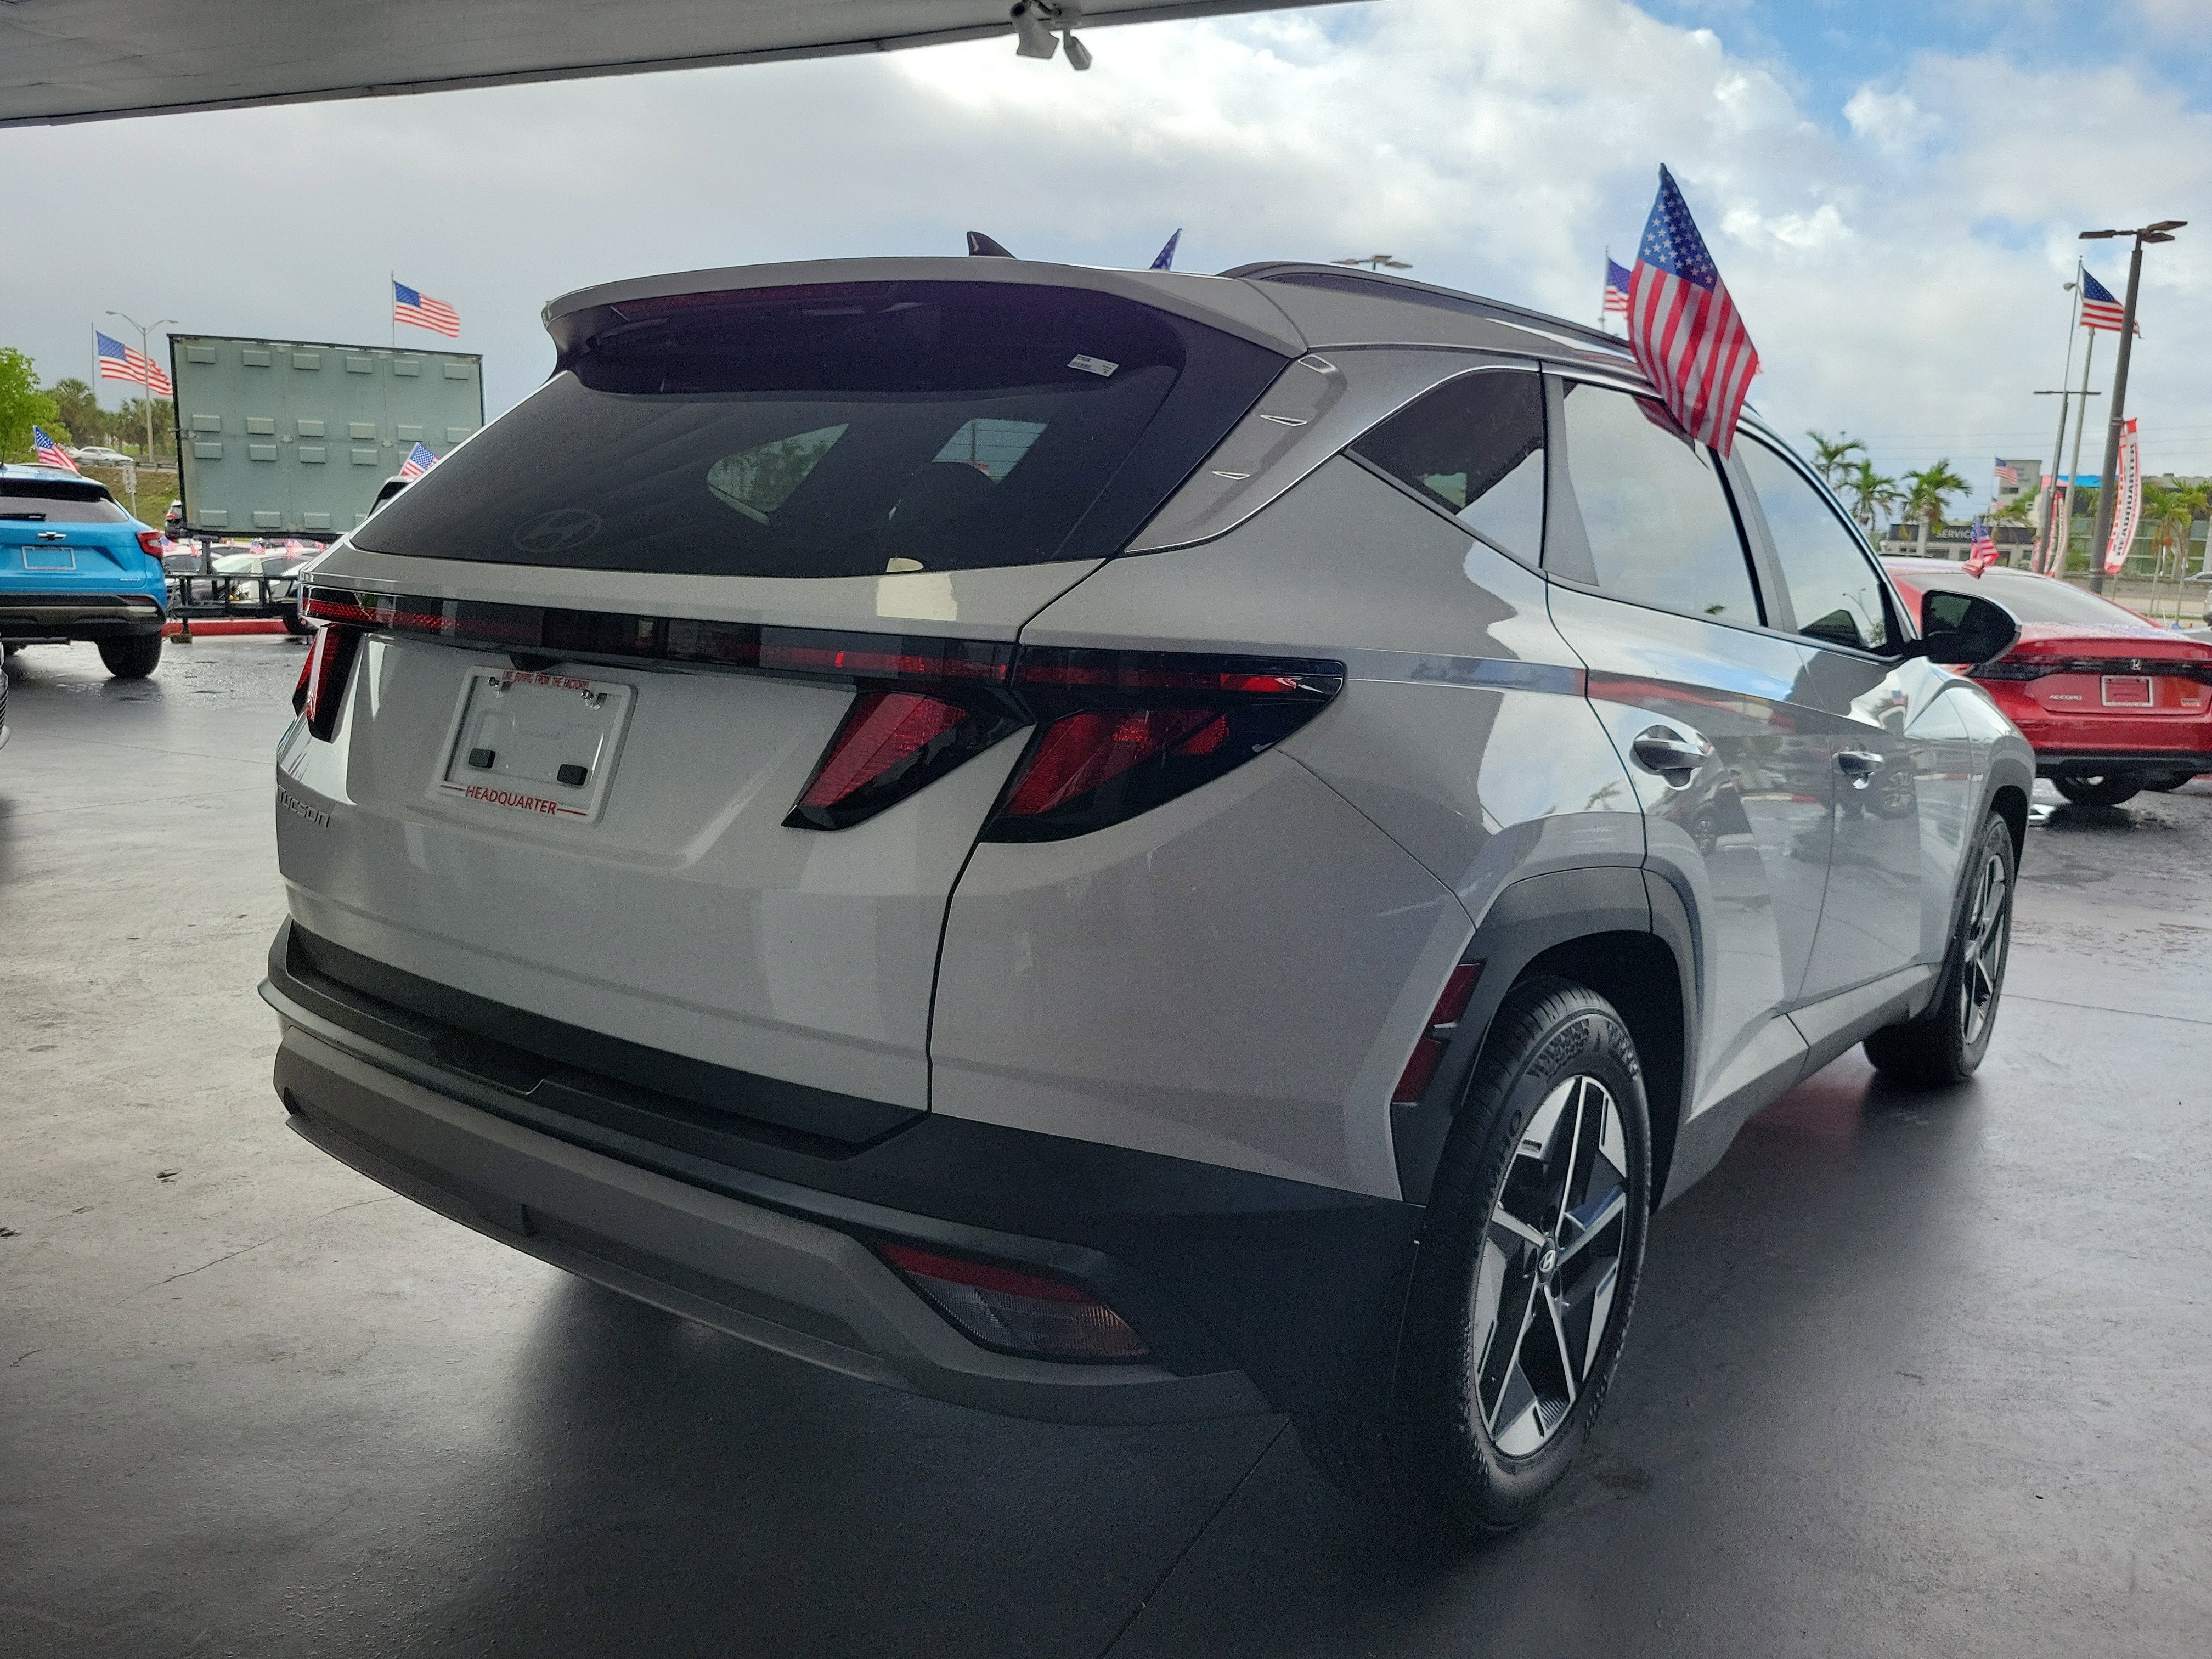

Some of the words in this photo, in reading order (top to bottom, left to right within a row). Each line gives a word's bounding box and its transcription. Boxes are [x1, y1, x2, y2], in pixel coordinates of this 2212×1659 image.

[1935, 528, 1973, 539] SERVIC
[278, 784, 330, 827] TUCSON
[465, 785, 556, 815] HEADQUARTER
